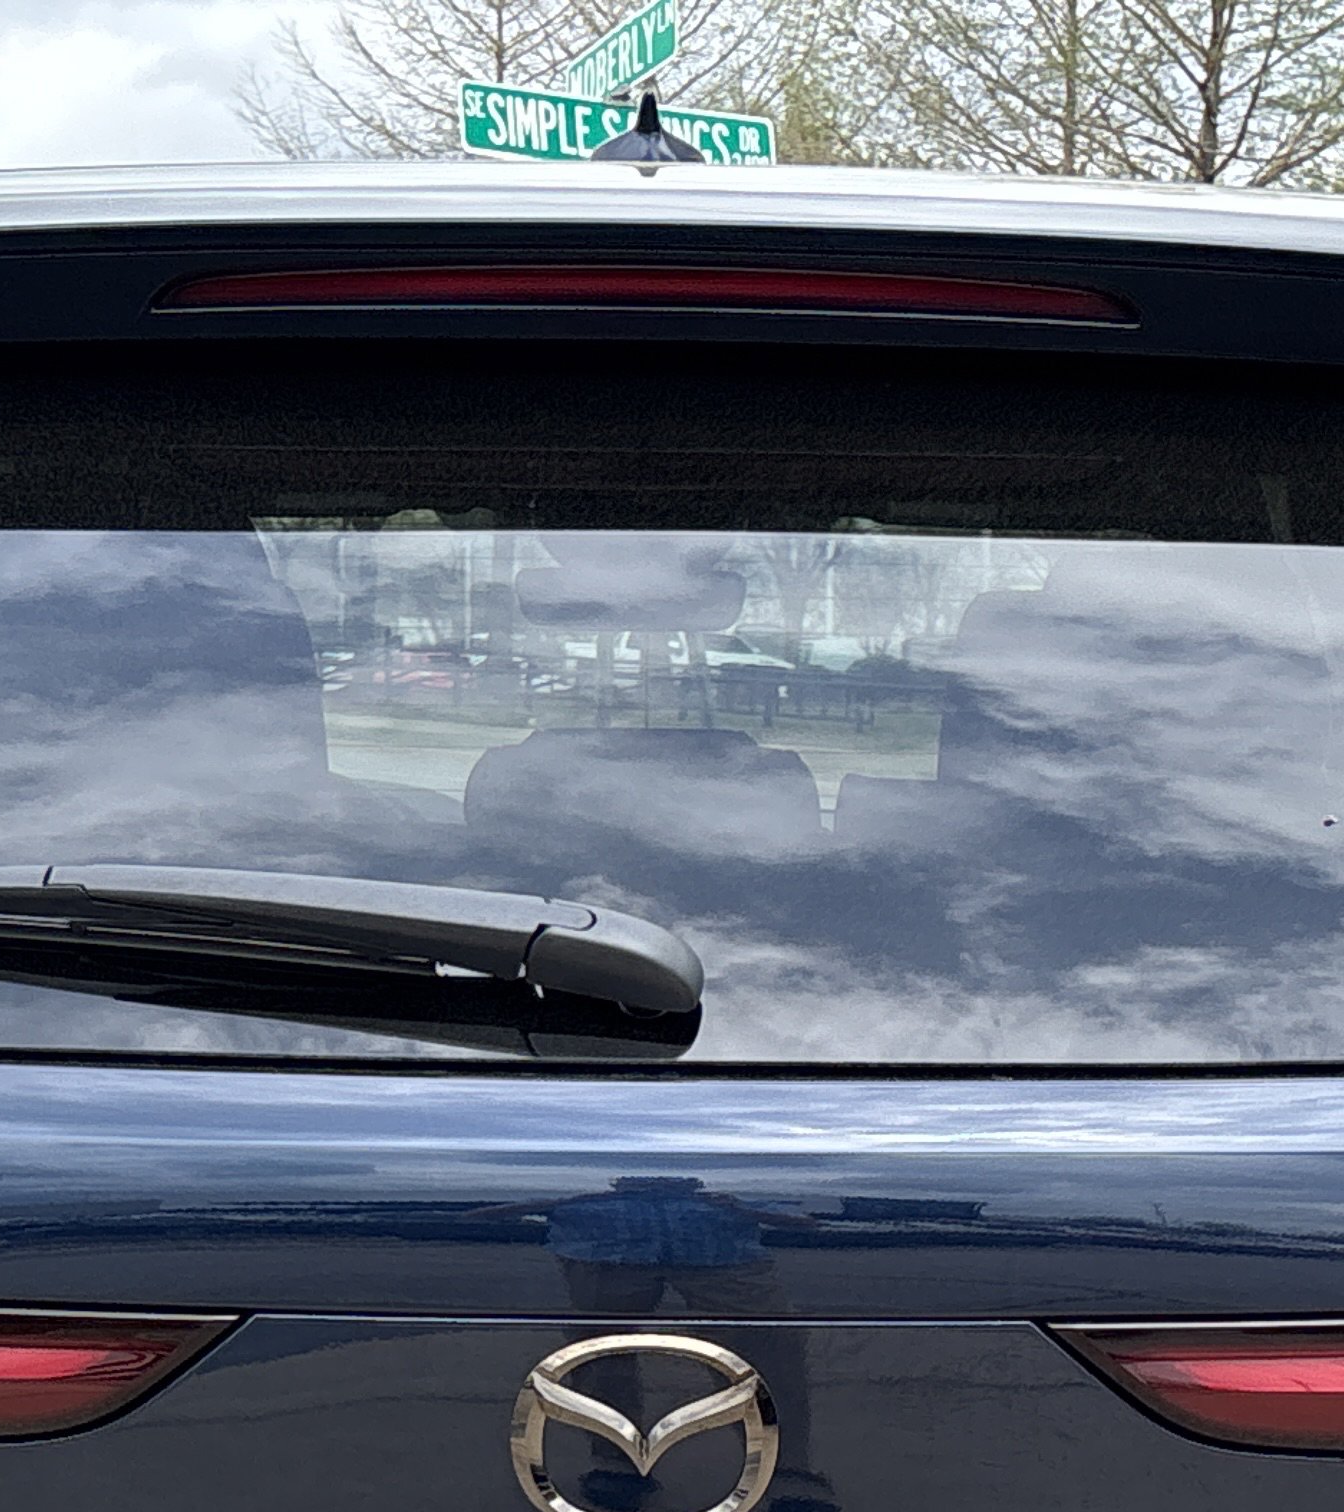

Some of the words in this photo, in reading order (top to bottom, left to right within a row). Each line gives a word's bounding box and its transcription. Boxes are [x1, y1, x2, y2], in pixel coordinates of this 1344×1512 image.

[570, 11, 656, 98] MOBERLY
[465, 89, 486, 118] SE
[486, 92, 594, 157] SIMPLE
[738, 126, 761, 154] DR
